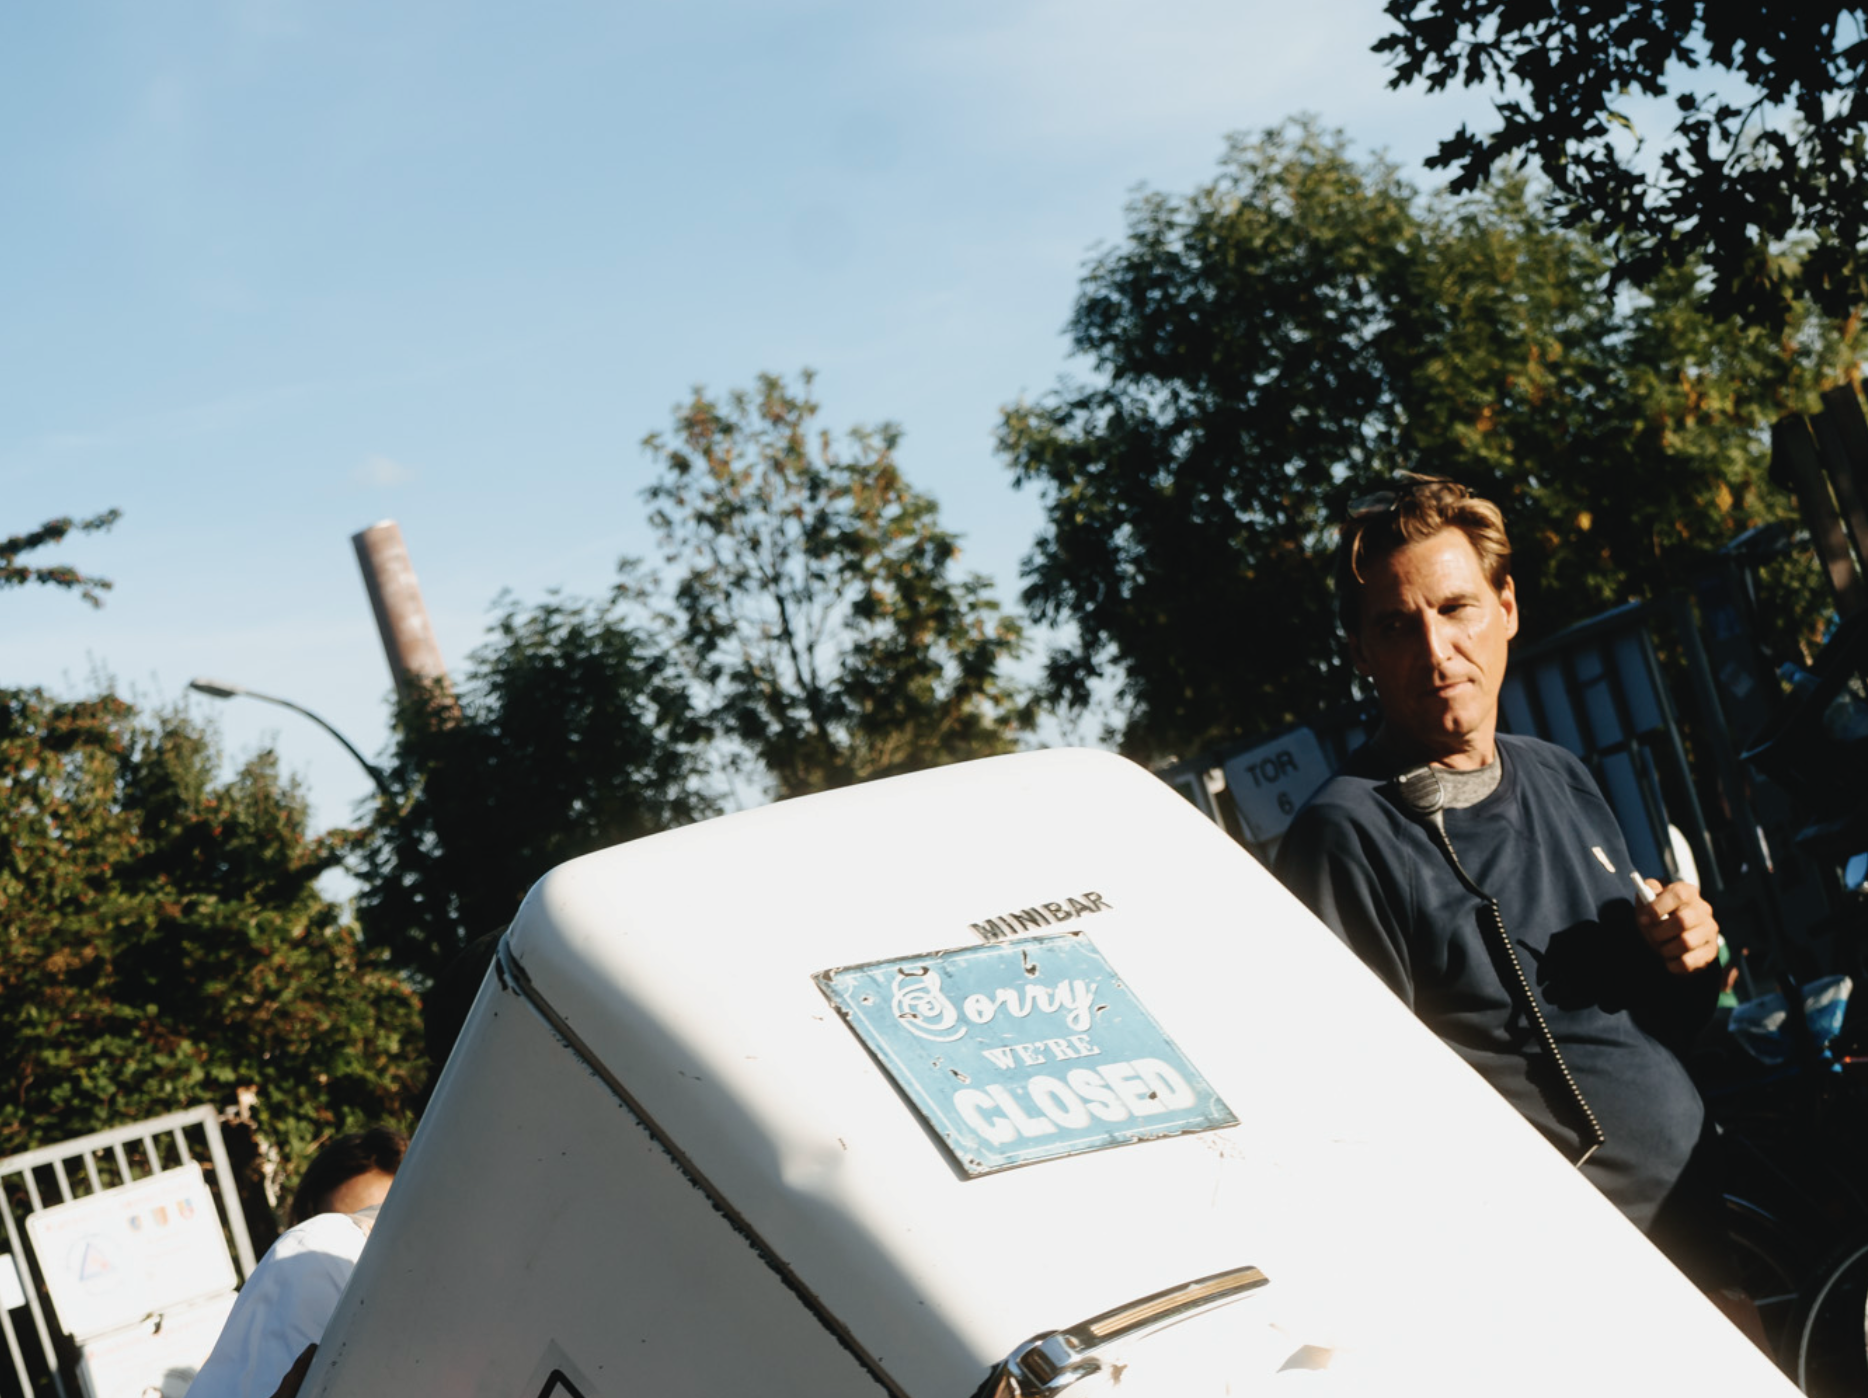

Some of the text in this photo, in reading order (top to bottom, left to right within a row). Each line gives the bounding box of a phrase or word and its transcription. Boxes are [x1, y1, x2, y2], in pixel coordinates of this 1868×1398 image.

[1245, 751, 1298, 788] TOR
[1276, 791, 1294, 815] 6
[968, 891, 1113, 942] MINIBAR
[892, 966, 1097, 1042] Sorry
[982, 1034, 1101, 1070] WE'RE
[952, 1057, 1197, 1145] CLOSED
